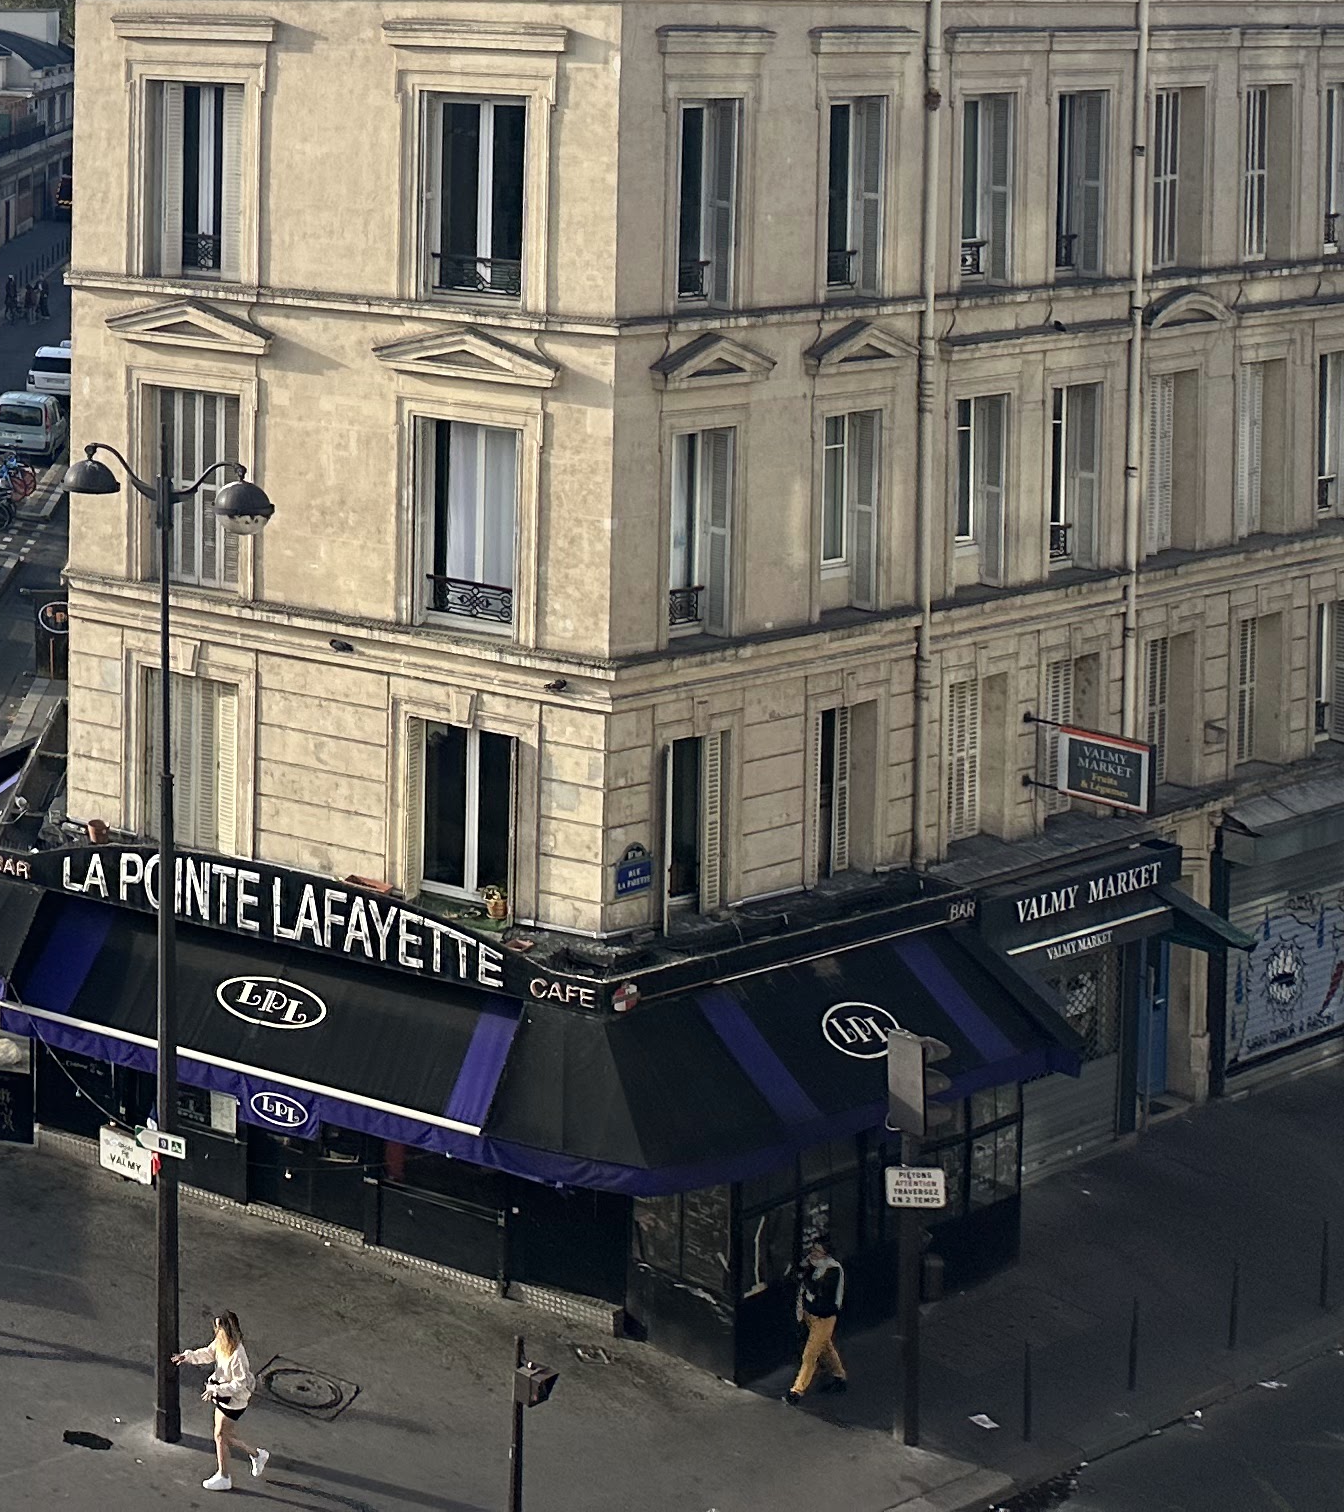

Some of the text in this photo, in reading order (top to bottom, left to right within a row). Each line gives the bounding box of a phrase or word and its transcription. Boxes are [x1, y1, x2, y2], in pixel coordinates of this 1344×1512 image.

[1077, 757, 1133, 778] MARKET
[1083, 745, 1128, 765] VALMY
[1016, 861, 1162, 923] VALMY MARKET
[62, 853, 109, 898] LA
[272, 876, 504, 988] LAFAYETTE
[949, 901, 976, 921] BAR
[1046, 930, 1113, 960] VALMY MARKET
[236, 980, 307, 1024] LPL
[529, 978, 596, 1009] CAFE
[828, 1016, 890, 1044] LPL
[262, 1095, 300, 1124] LPL
[109, 1153, 142, 1173] VALMY
[893, 1188, 939, 1196] TRAVERSEZ
